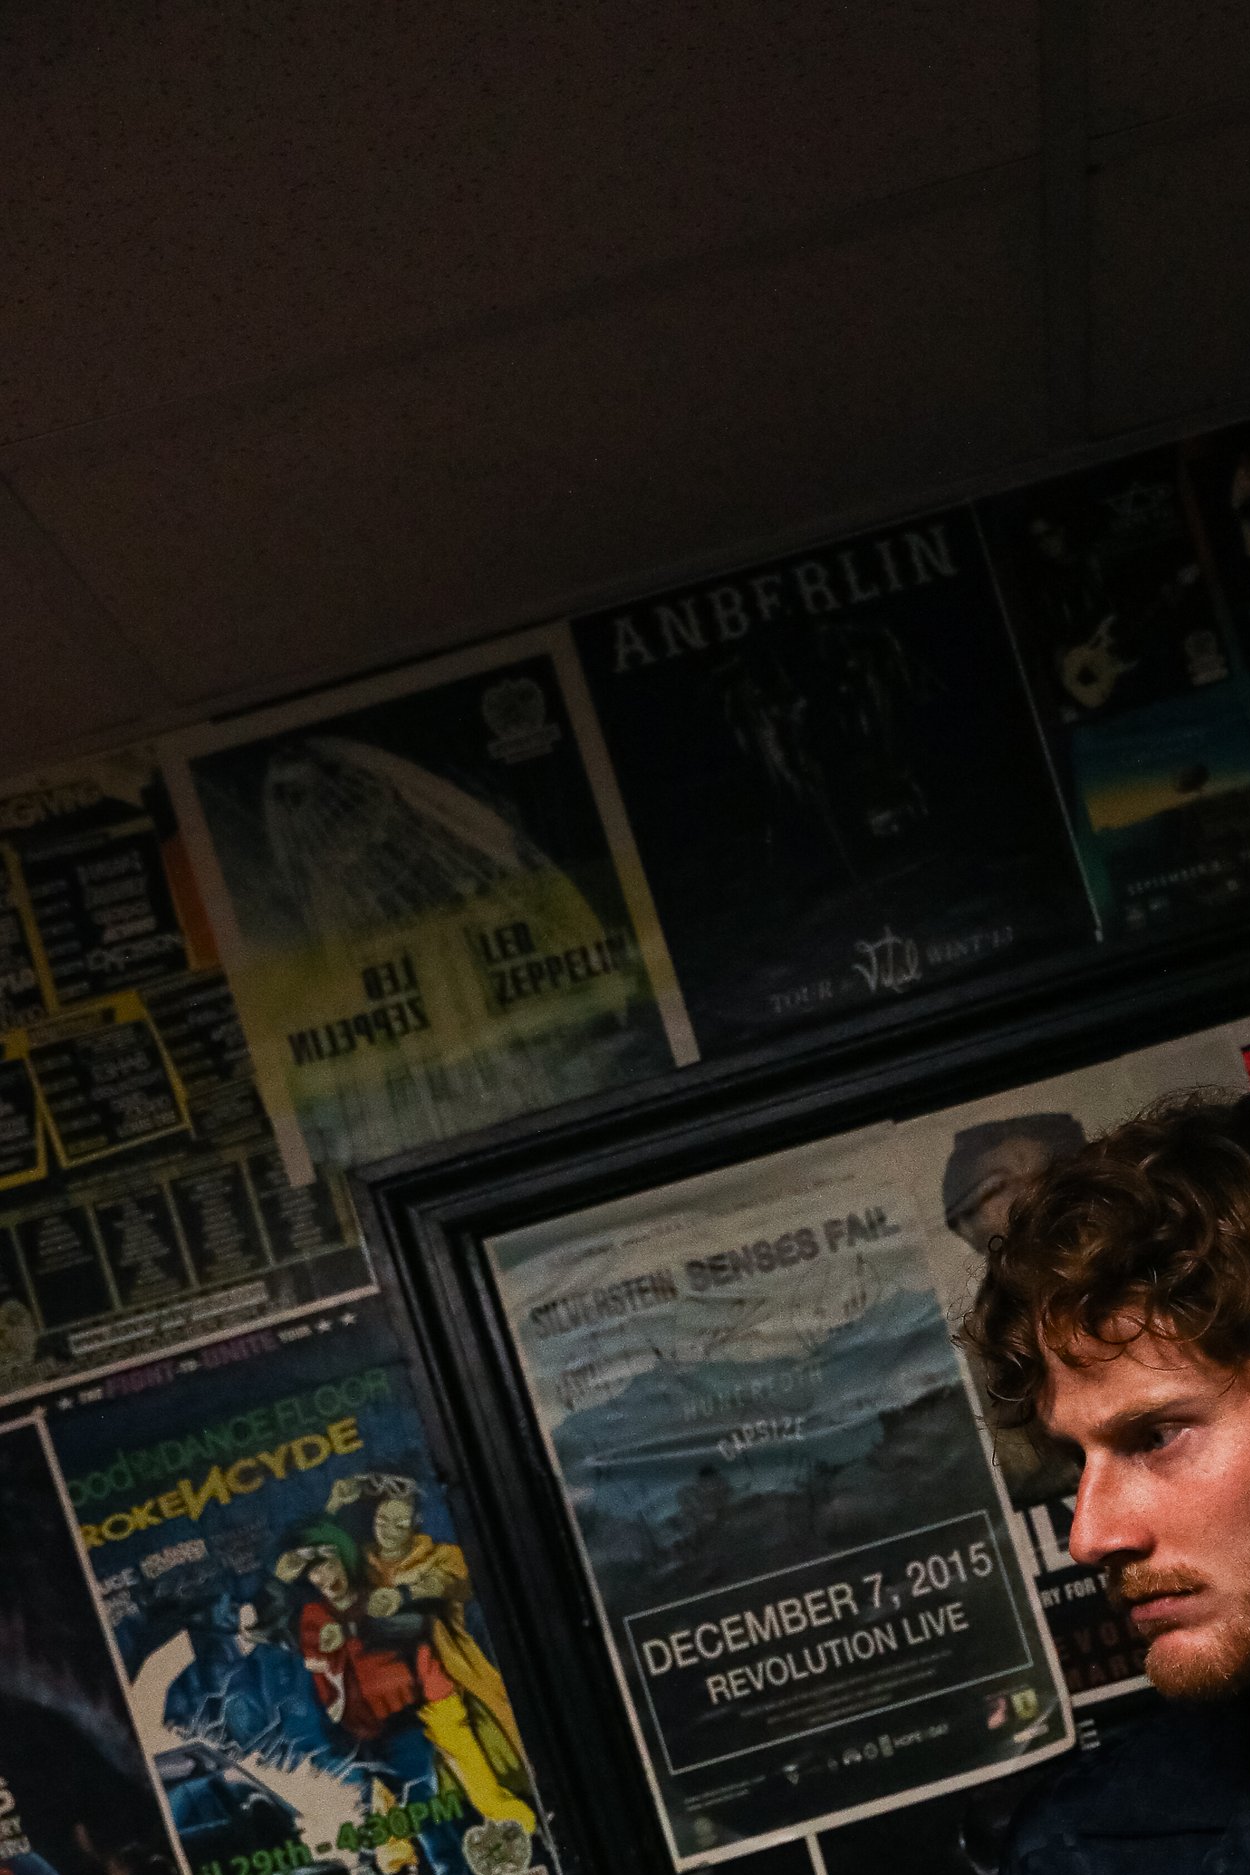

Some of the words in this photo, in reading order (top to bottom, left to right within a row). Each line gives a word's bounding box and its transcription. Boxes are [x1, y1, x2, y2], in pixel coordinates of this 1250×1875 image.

[611, 524, 960, 674] ANBERLIN
[480, 921, 534, 965] LED
[685, 1228, 822, 1292] SENSES
[823, 1206, 901, 1254] FAIL
[161, 1406, 275, 1472] DANCE
[277, 1367, 392, 1424] FLOOR
[80, 1415, 365, 1549] ROKENCYDE
[641, 1580, 860, 1678] DECEMBER
[862, 1572, 902, 1610] 7,
[904, 1541, 994, 1599] 2015
[1063, 1576, 1097, 1601] FOR
[705, 1624, 899, 1705] REVOLUTION
[902, 1601, 971, 1647] LIVE
[336, 1788, 465, 1852] 4:30PM
